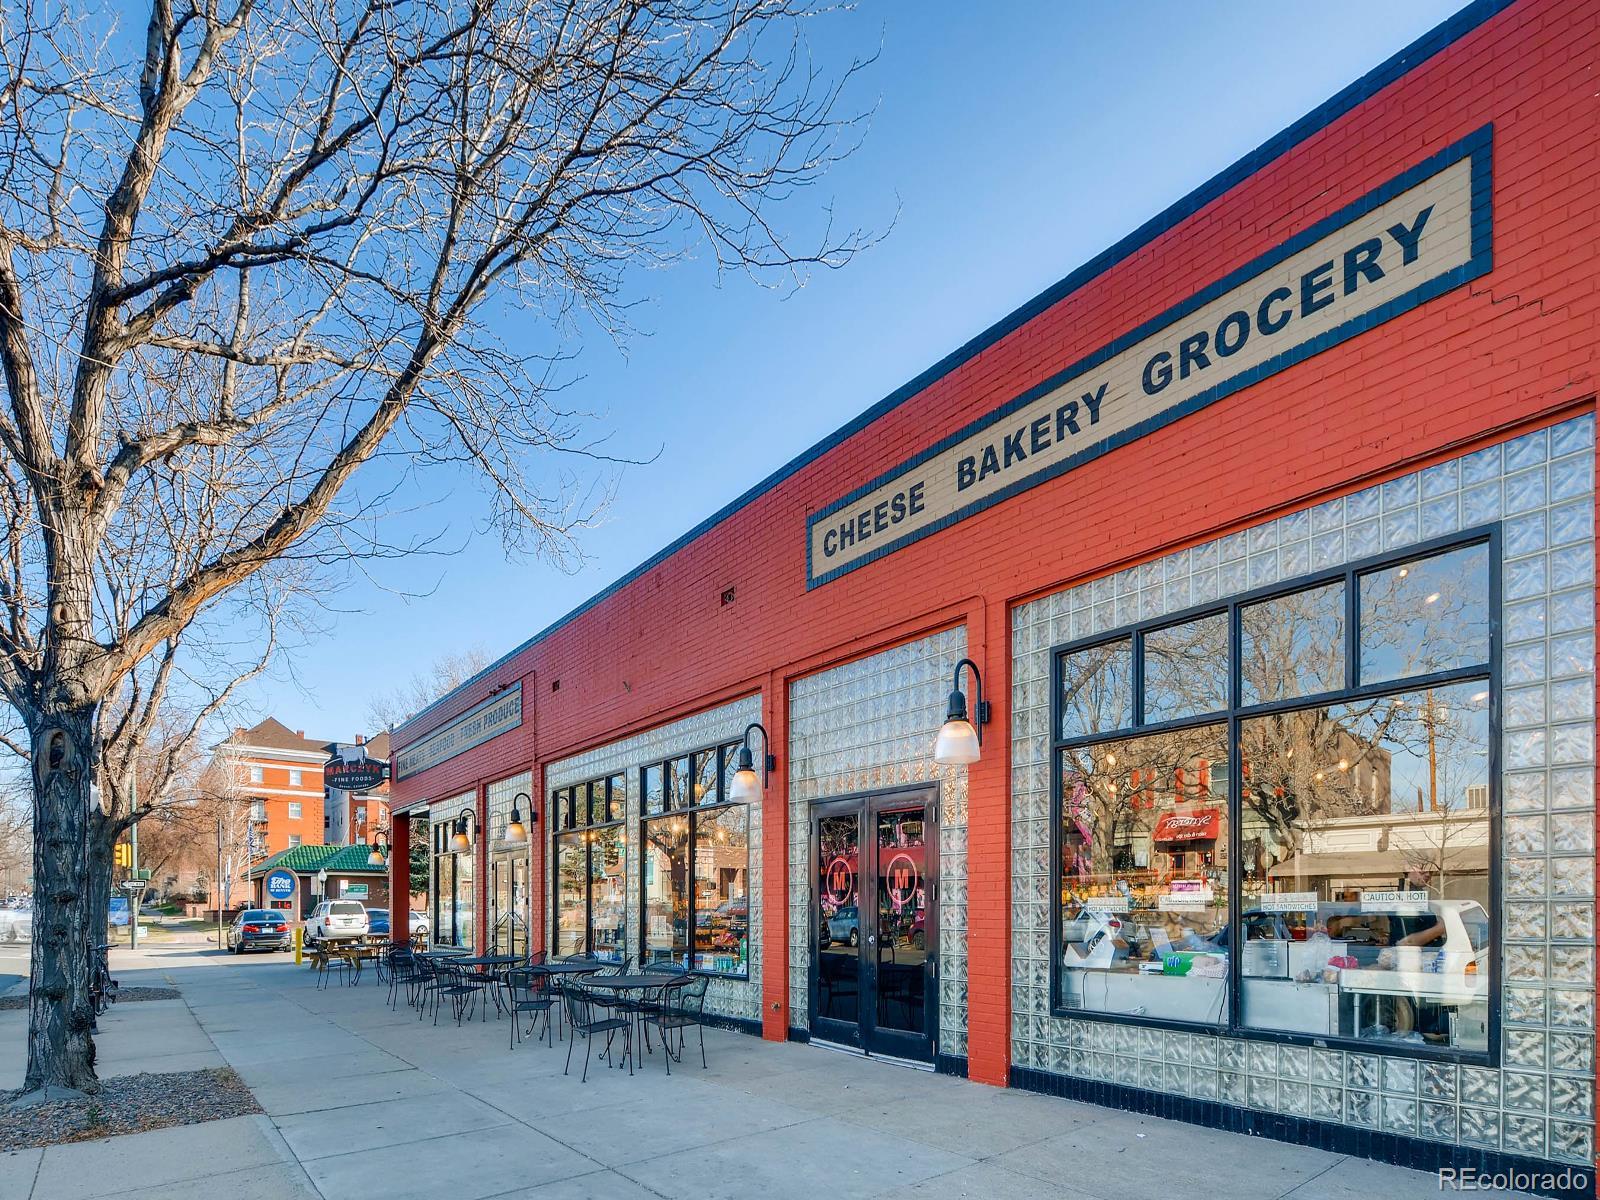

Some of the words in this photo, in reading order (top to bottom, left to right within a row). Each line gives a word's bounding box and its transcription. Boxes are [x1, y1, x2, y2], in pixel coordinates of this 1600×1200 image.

[823, 481, 925, 558] CHEESE
[957, 381, 1109, 492] BAKERY
[1142, 203, 1436, 396] GROCERY
[483, 697, 520, 729] PRODUCE
[833, 871, 845, 891] M
[894, 868, 909, 889] M
[1363, 892, 1403, 902] CAUTION,
[1407, 891, 1427, 900] HOT!
[1263, 903, 1275, 911] HOT
[1276, 903, 1316, 911] SANDWICHES
